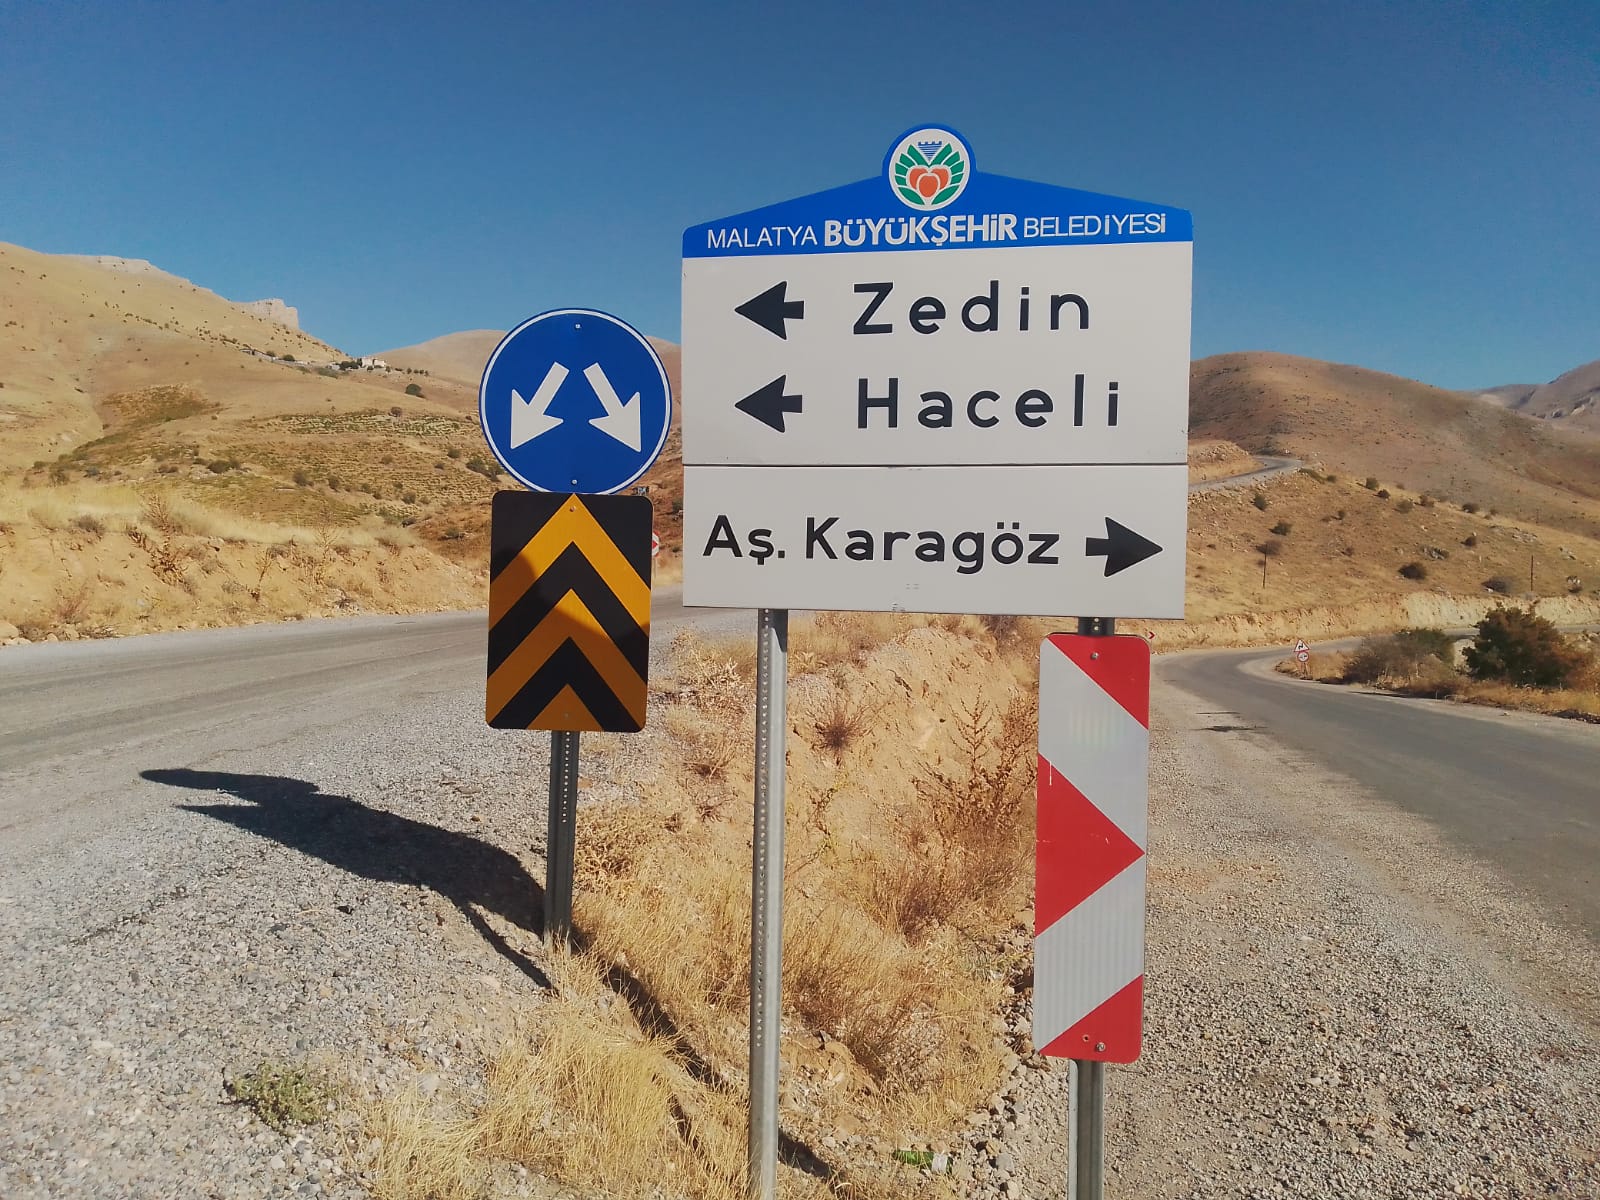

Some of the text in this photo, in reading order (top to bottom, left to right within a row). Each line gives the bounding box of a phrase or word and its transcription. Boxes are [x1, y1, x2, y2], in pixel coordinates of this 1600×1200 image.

[707, 213, 1166, 249] MALATYA BÜYÜKŞEHİR BELEDİYESİ
[853, 279, 1089, 335] Zedin
[857, 373, 1119, 429] Haceli
[702, 514, 1060, 575] Aş. Karagöz
